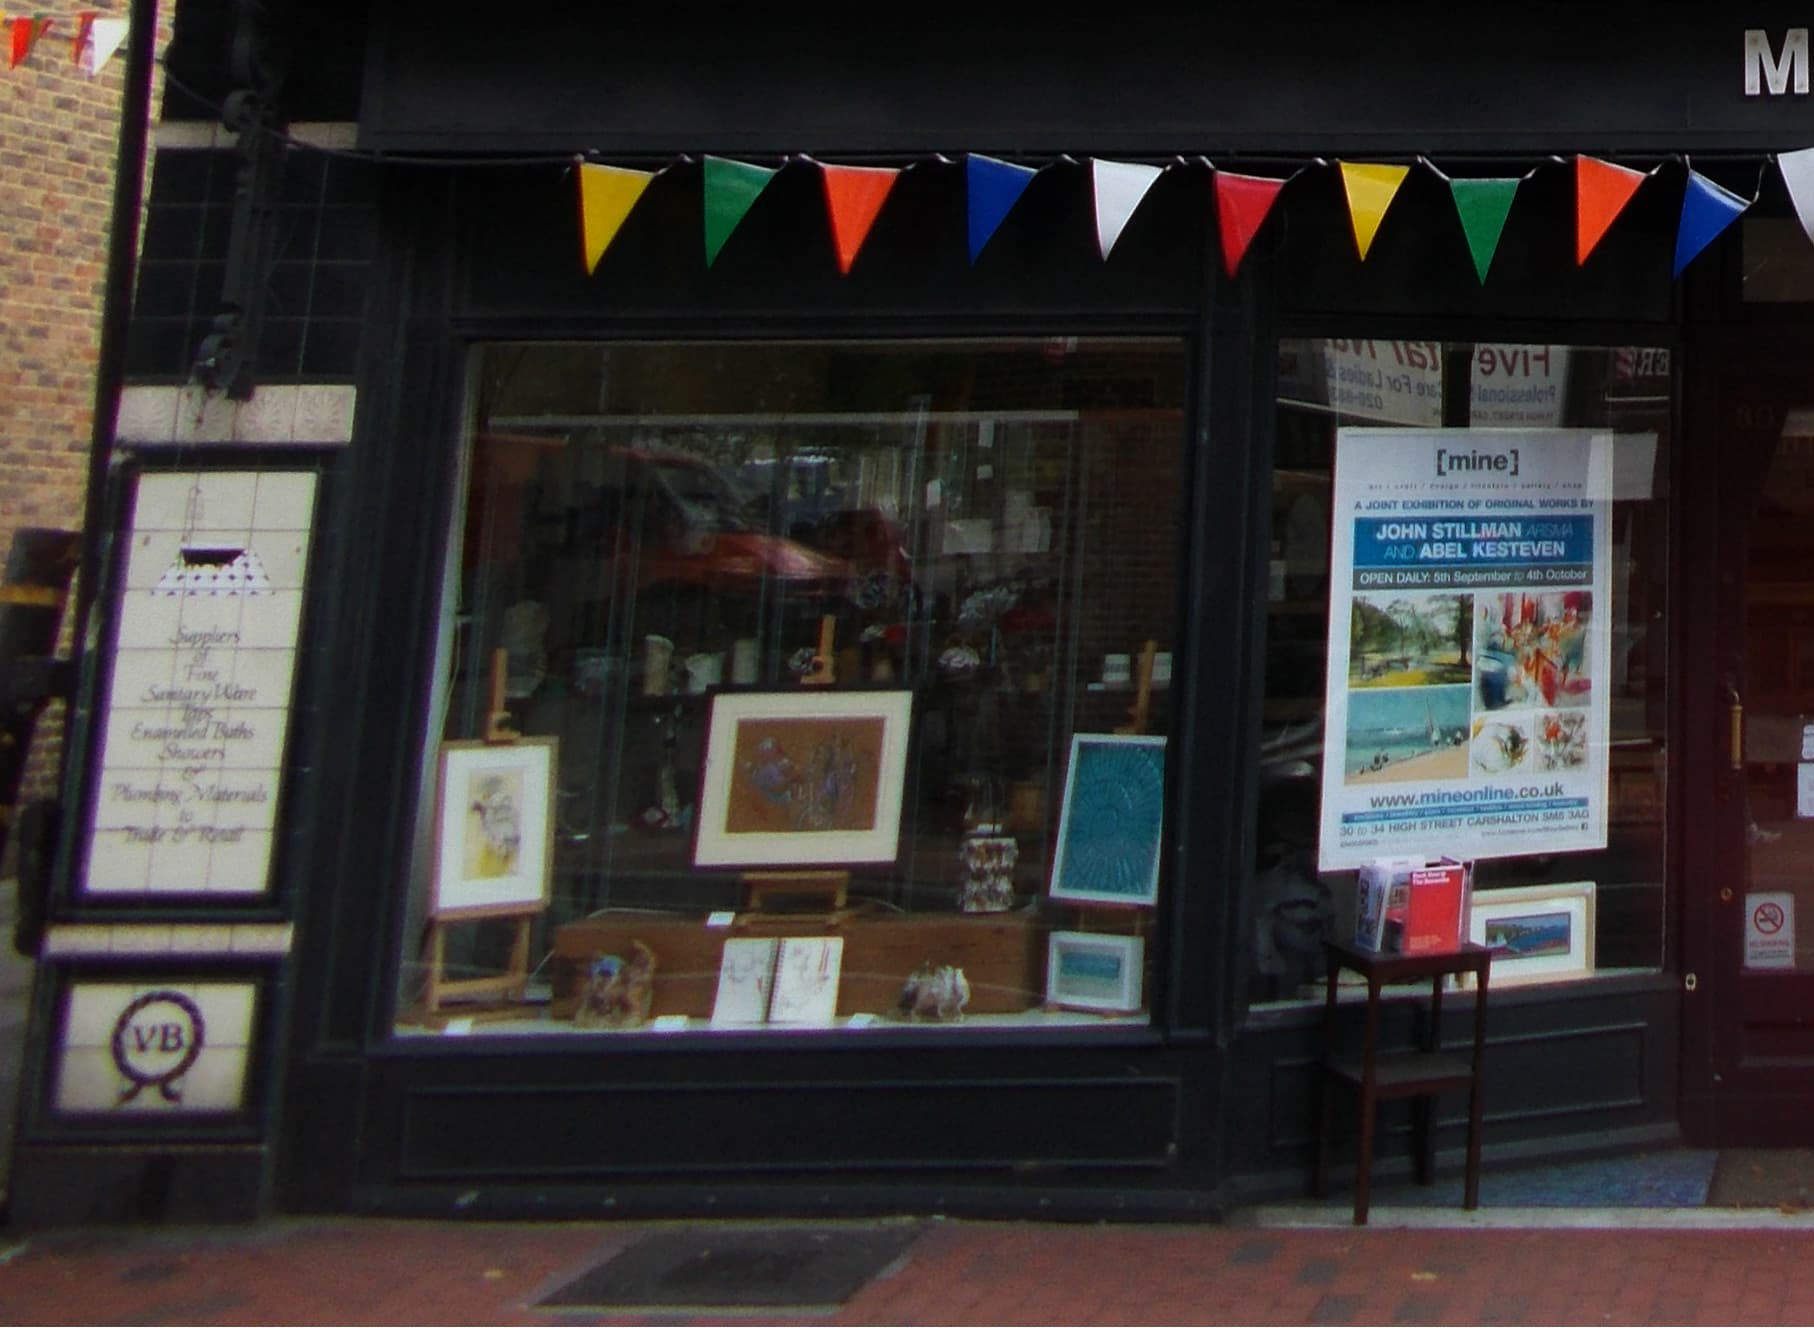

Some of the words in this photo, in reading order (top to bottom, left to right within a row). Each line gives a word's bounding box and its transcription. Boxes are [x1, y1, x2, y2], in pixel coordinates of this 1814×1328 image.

[1354, 500, 1362, 510] A
[1366, 500, 1399, 510] JOINT
[1402, 499, 1464, 509] EXHIBITION
[1467, 499, 1482, 509] OF
[1485, 499, 1535, 509] ORIGINAL
[1539, 498, 1578, 508] WORKS
[1581, 498, 1594, 508] BY
[1376, 525, 1427, 540] JOHN
[1432, 523, 1522, 539] STILLMAN
[1383, 545, 1416, 560] AND
[1420, 543, 1467, 559] ABEL
[1473, 541, 1564, 557] KESTEVEN
[1360, 572, 1392, 584] OPEN
[1433, 570, 1451, 583] 5th
[1454, 569, 1512, 584] September
[1526, 568, 1543, 580] 4th
[1545, 567, 1587, 580] October
[1370, 782, 1564, 808] www.mineonline.co.uk
[1341, 825, 1353, 836] 30
[1371, 823, 1384, 834] 34
[1389, 822, 1416, 832] HIGH
[1420, 819, 1462, 831] STREET
[1467, 814, 1539, 826] CARSHALTON
[132, 1023, 184, 1053] VB
